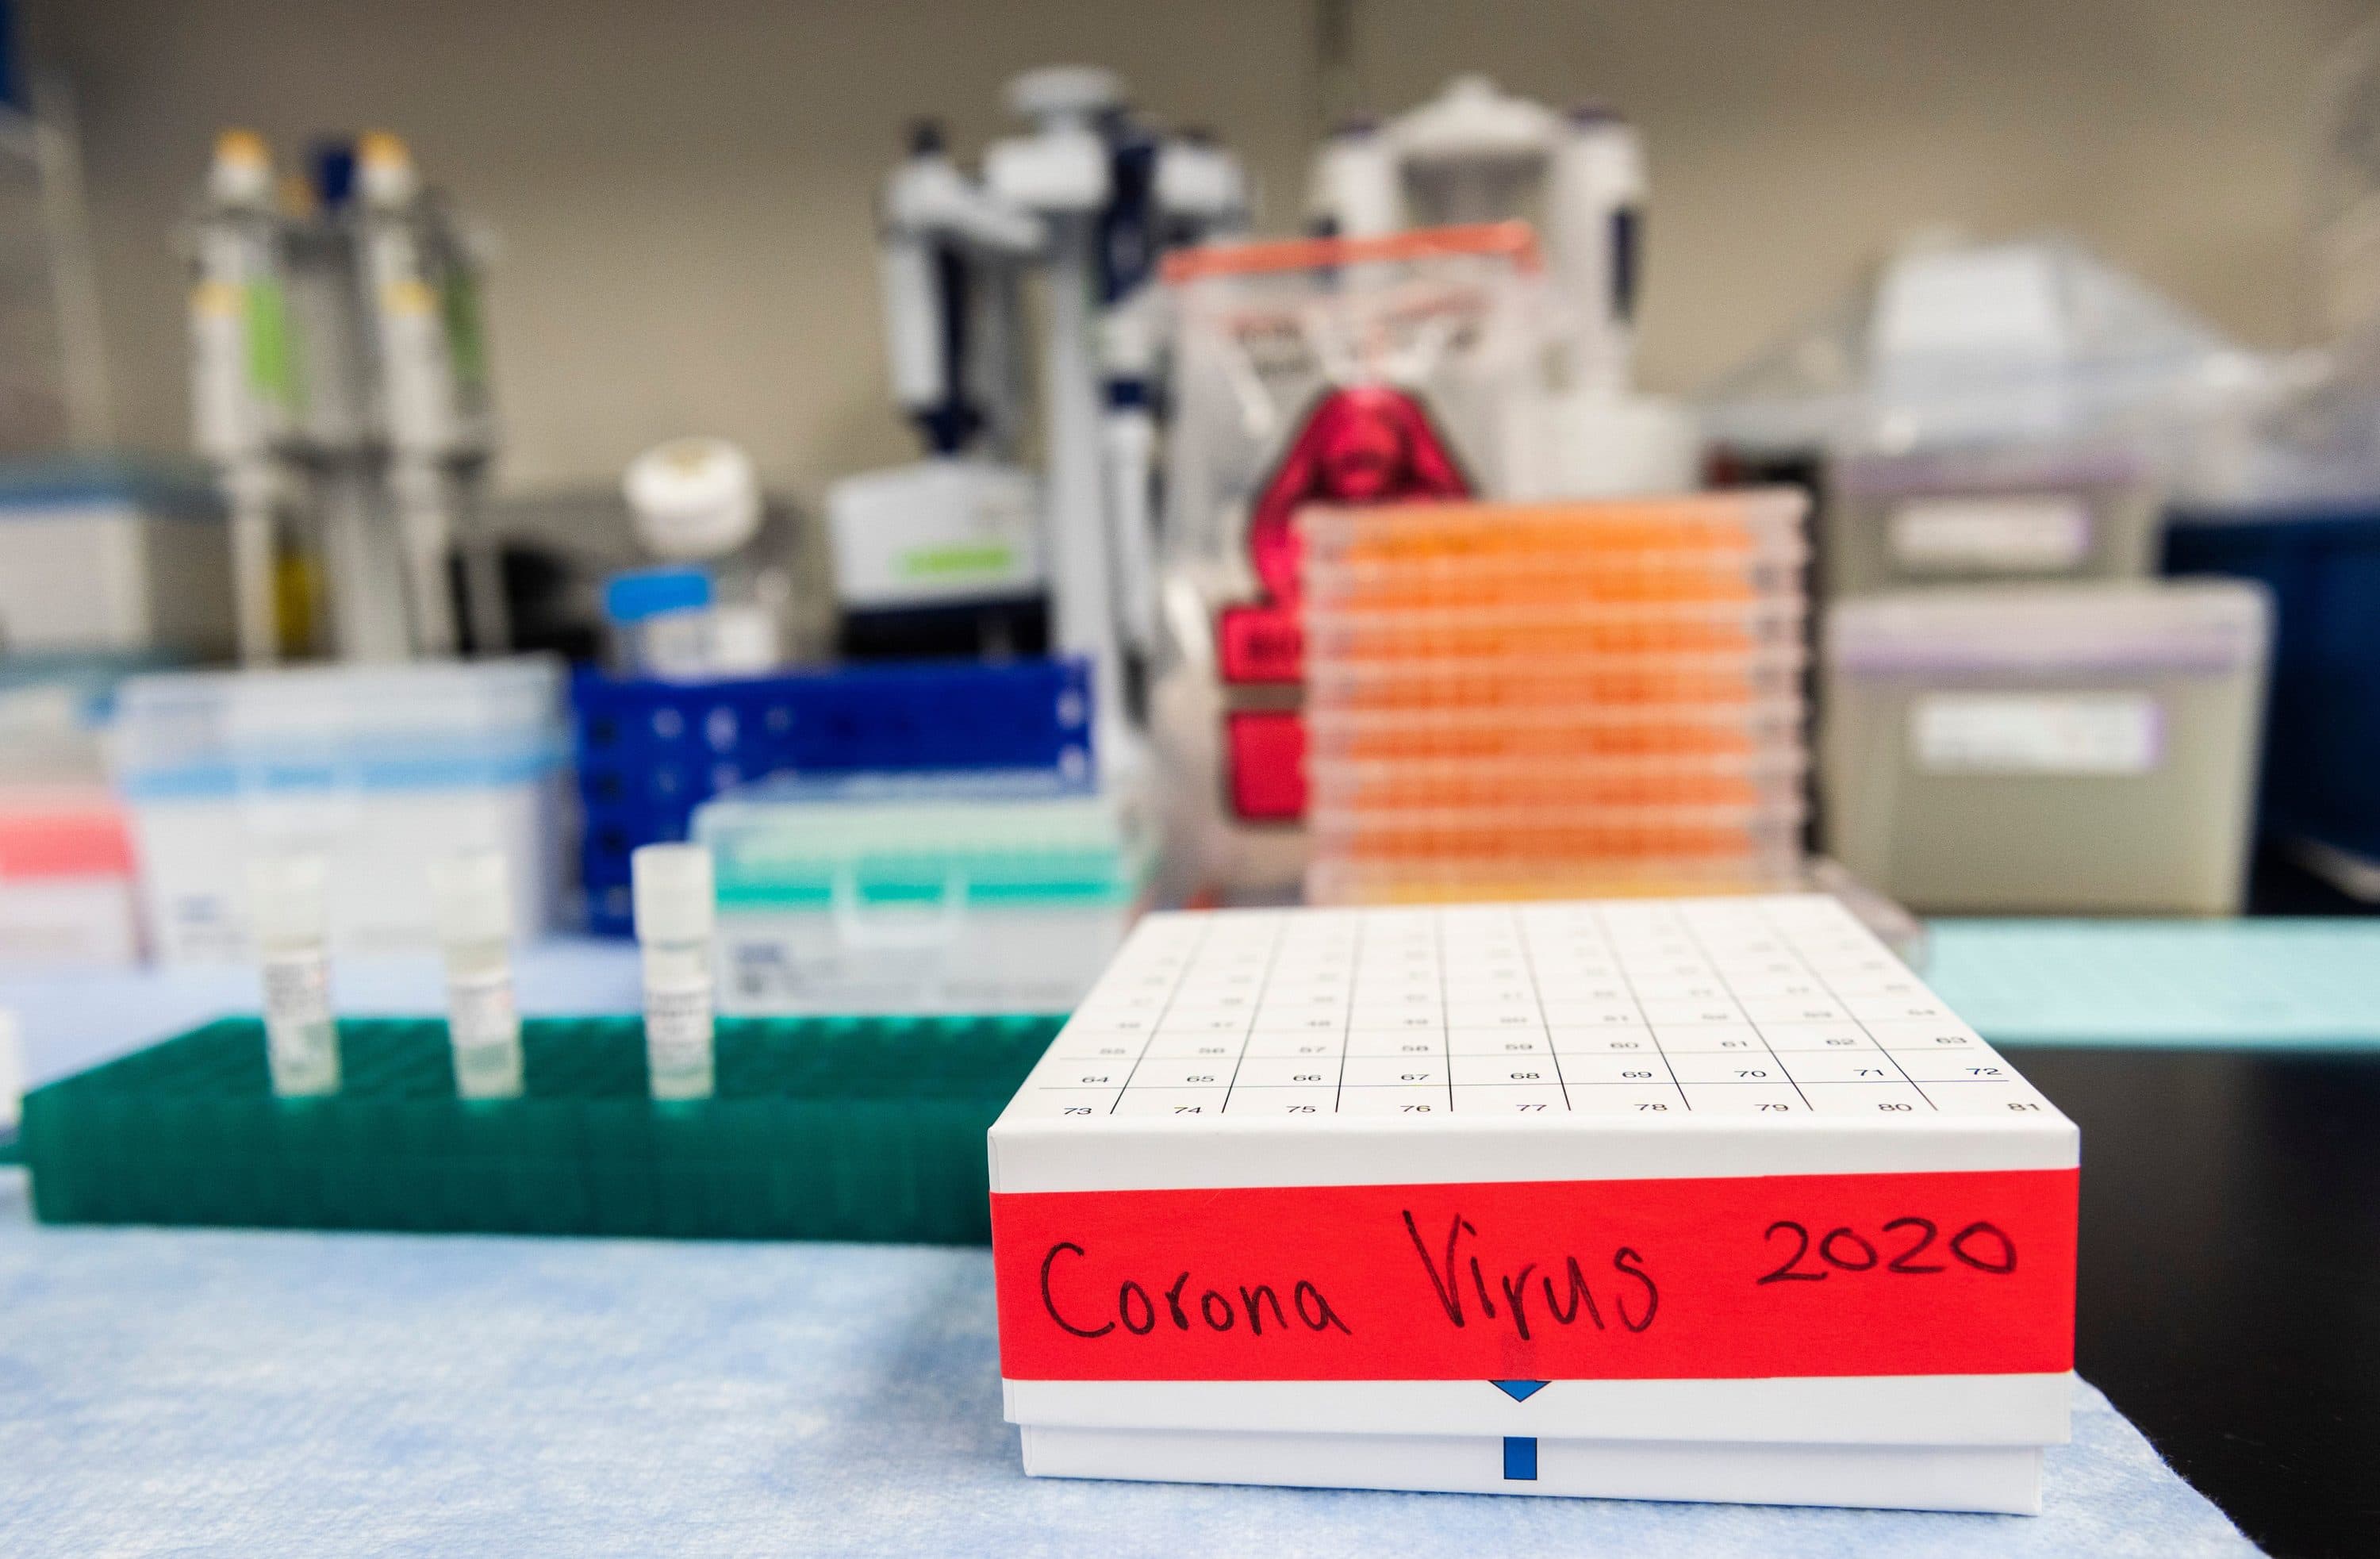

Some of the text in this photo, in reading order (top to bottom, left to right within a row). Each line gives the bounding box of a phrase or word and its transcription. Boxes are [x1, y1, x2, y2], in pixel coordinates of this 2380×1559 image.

[1965, 1067, 2002, 1076] 72
[2007, 1103, 2040, 1112] 81
[1040, 1209, 2017, 1342] Corona Virus 2020
